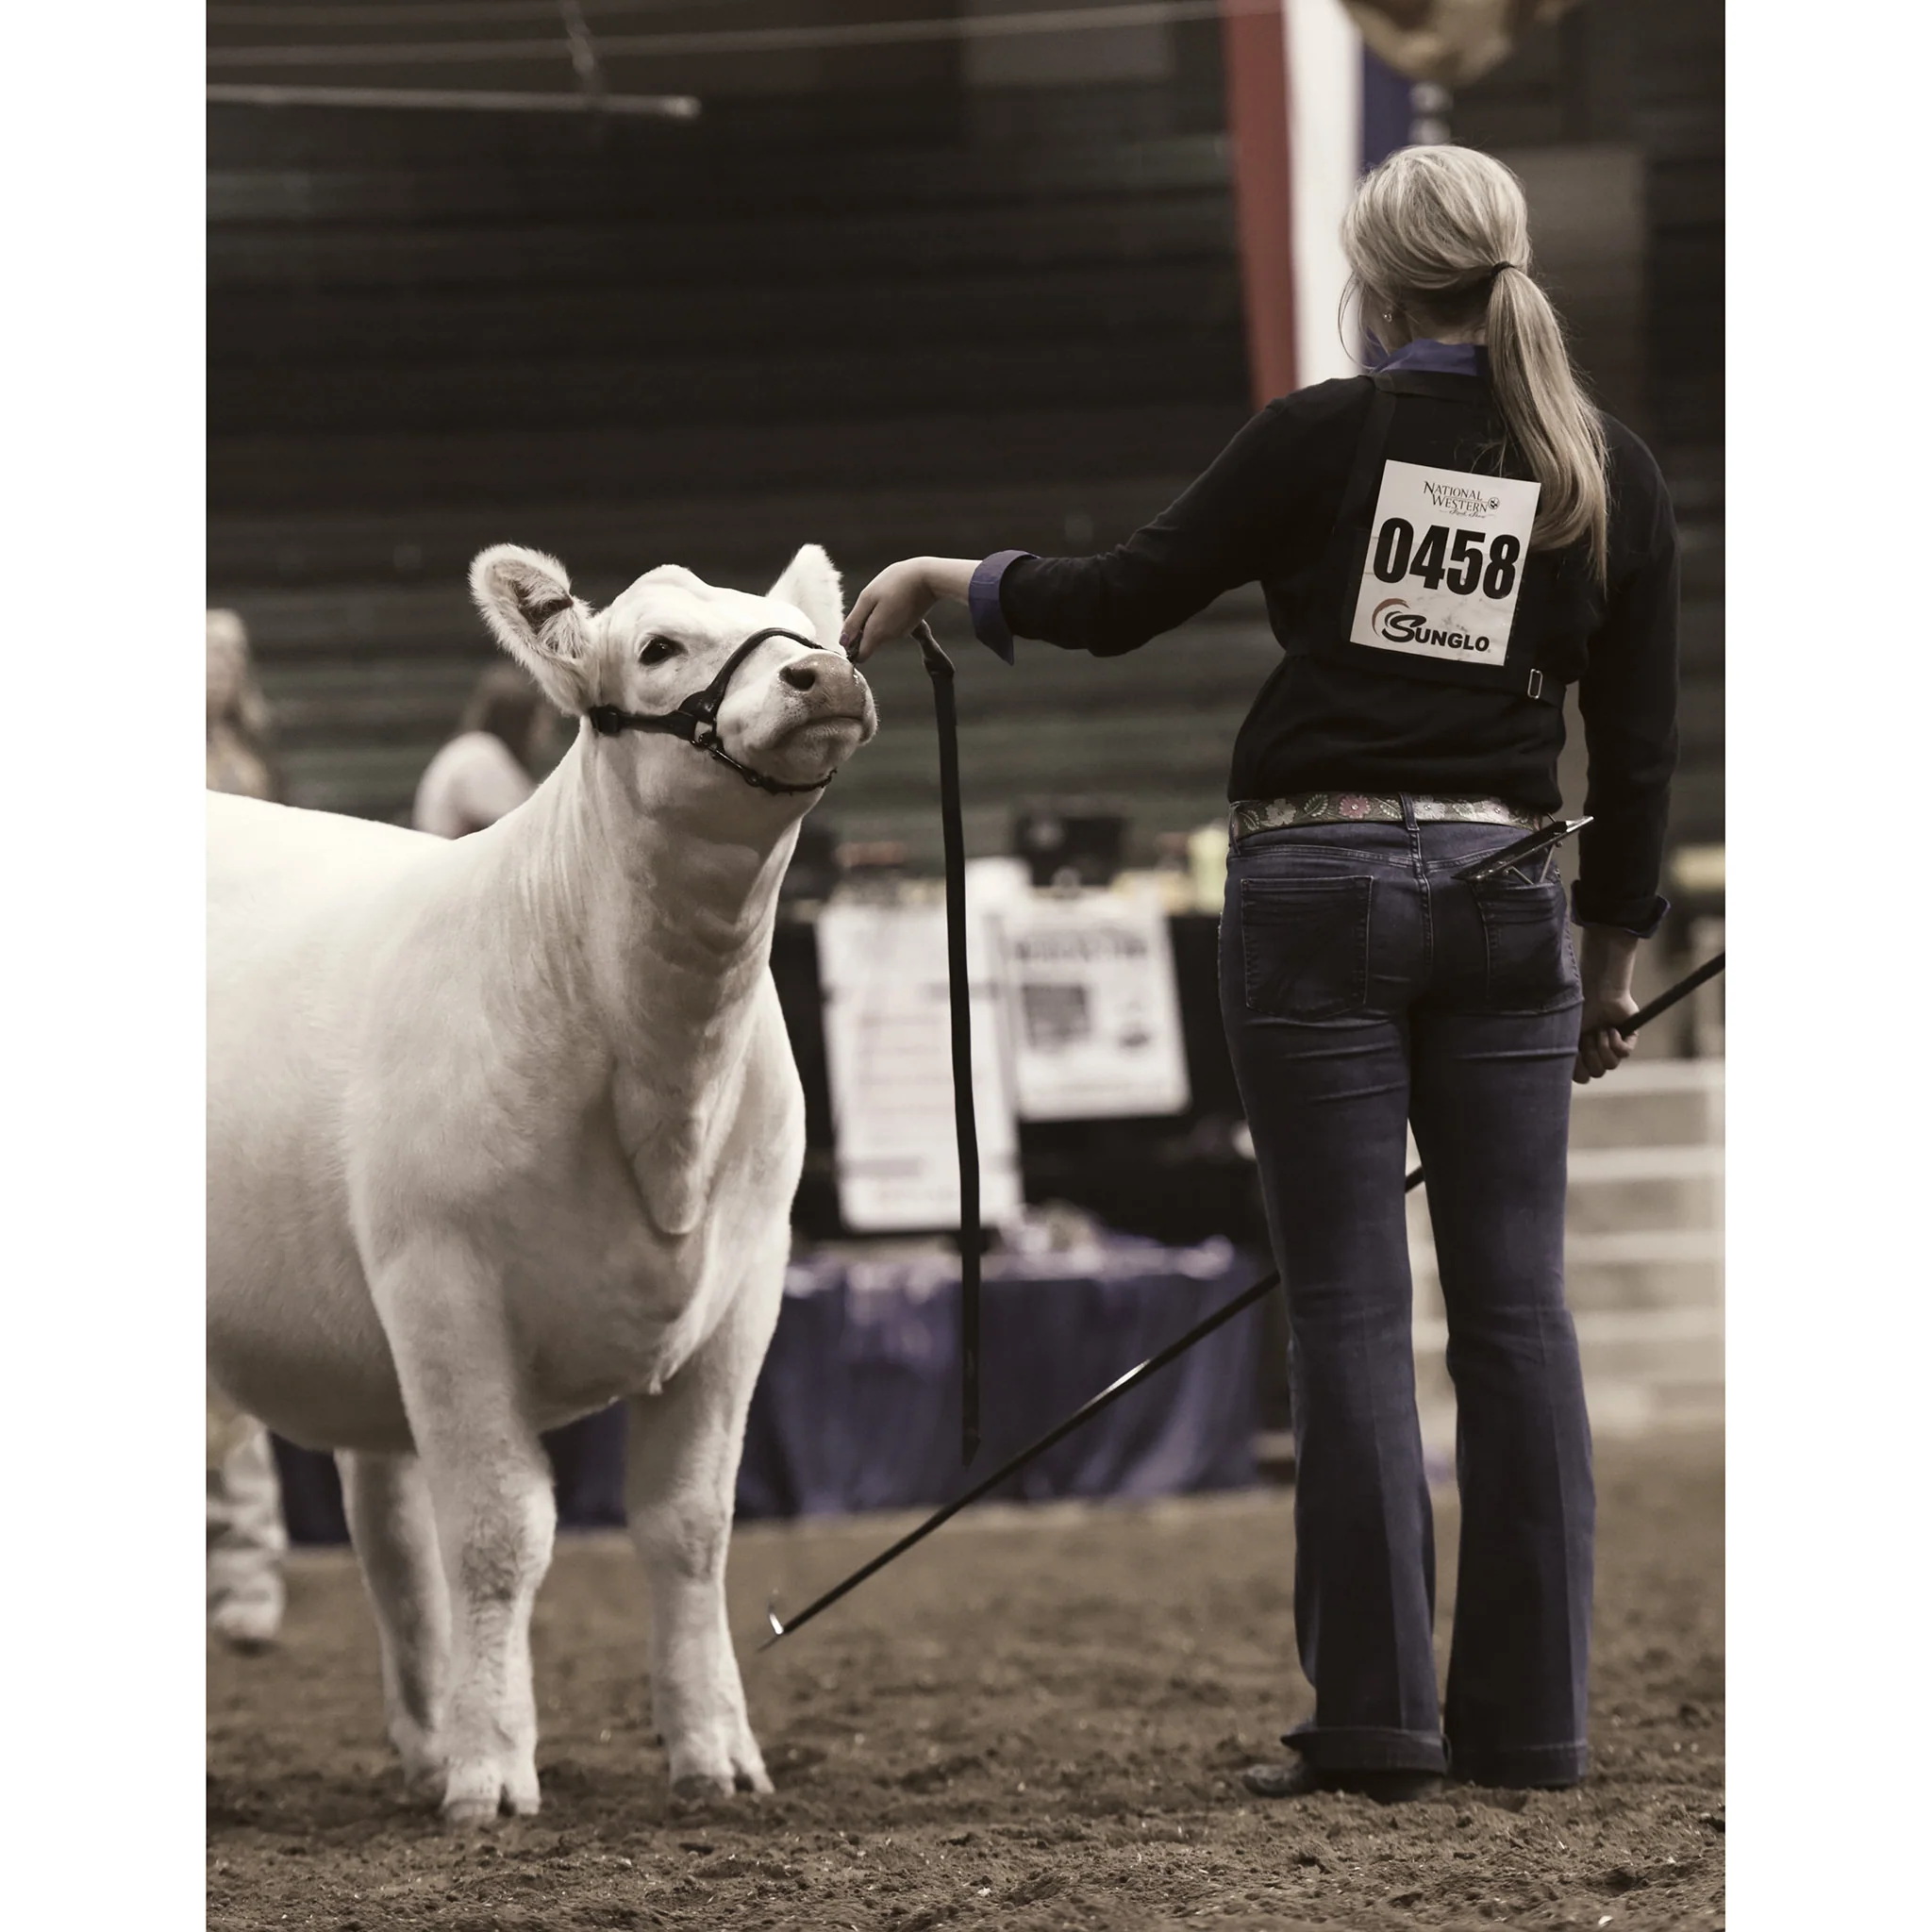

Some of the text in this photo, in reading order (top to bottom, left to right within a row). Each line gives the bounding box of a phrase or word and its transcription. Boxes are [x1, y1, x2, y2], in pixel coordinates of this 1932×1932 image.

[1424, 480, 1483, 501] NATIONAL
[1432, 493, 1488, 512] WESTERN
[1374, 517, 1521, 599] 0458
[1382, 611, 1490, 652] SUNGLO
